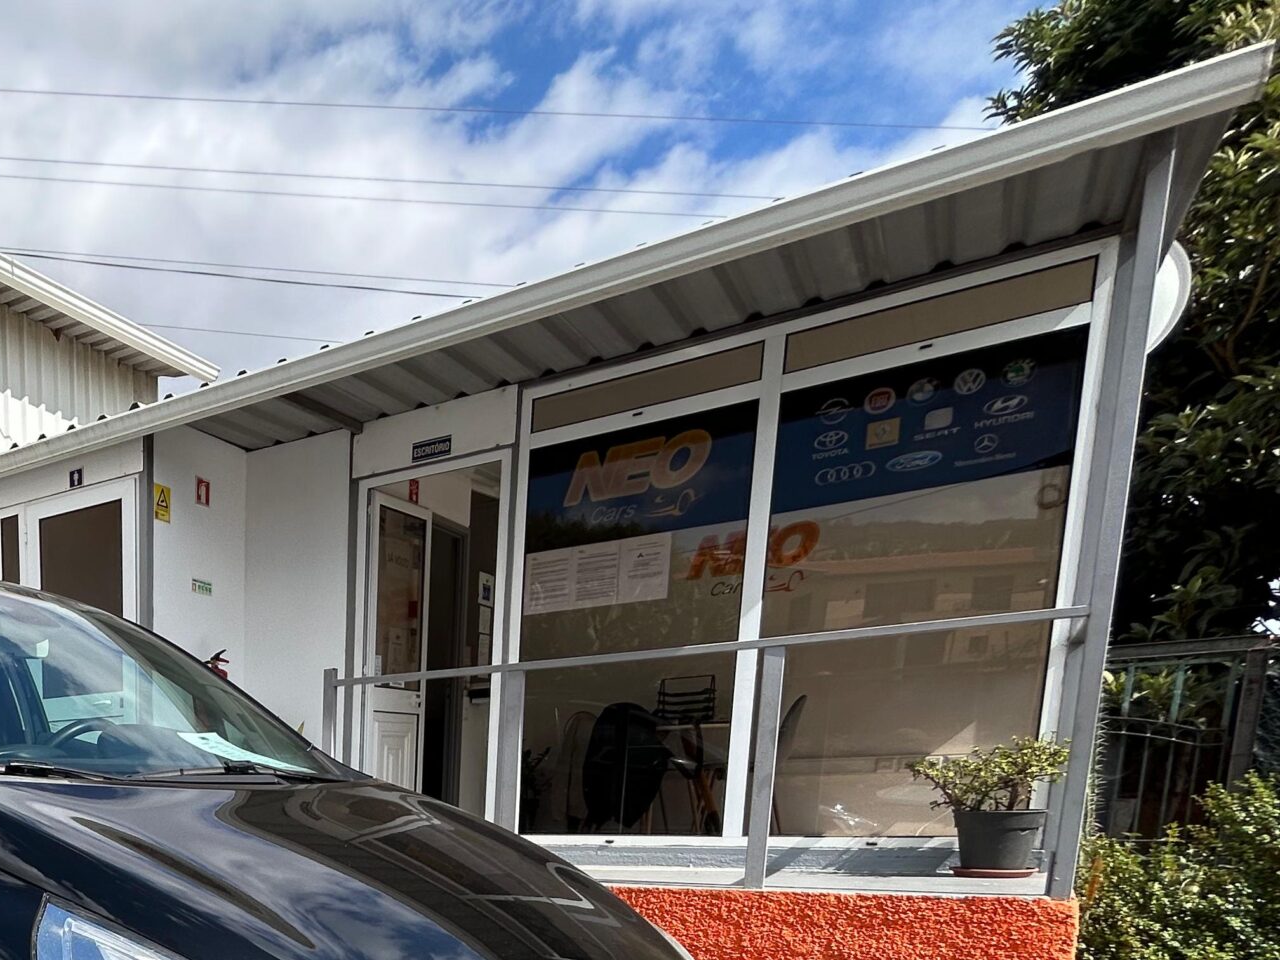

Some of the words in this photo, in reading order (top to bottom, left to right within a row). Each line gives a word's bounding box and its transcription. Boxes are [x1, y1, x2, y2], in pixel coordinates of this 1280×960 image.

[974, 411, 1035, 429] HYUNDAI
[913, 426, 961, 441] SEAT
[413, 441, 450, 458] ESCRITÓRIO
[812, 448, 849, 460] TOYOTA
[563, 429, 712, 507] NEO
[591, 503, 638, 524] Cars
[711, 579, 742, 597] Car
